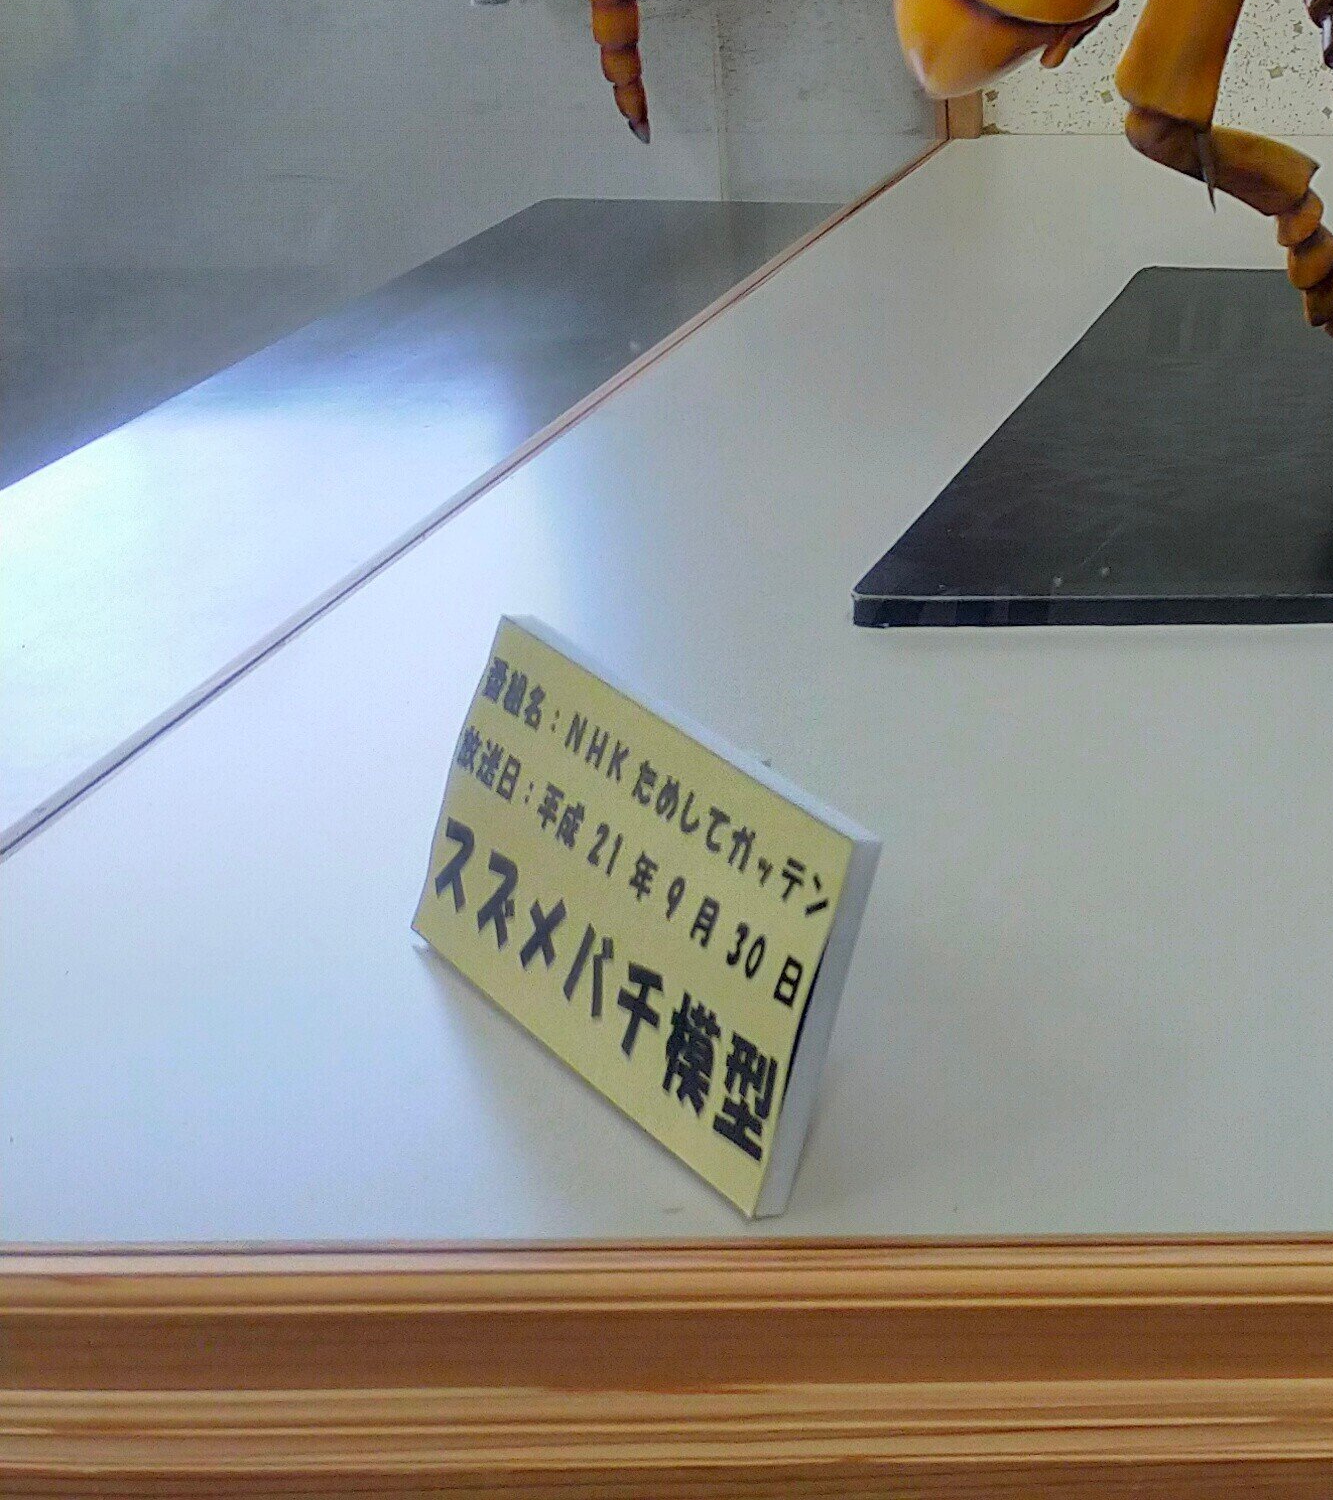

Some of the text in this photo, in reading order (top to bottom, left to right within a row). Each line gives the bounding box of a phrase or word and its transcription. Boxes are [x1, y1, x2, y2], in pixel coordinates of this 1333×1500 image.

[435, 817, 777, 1161] スズメバチ模型
